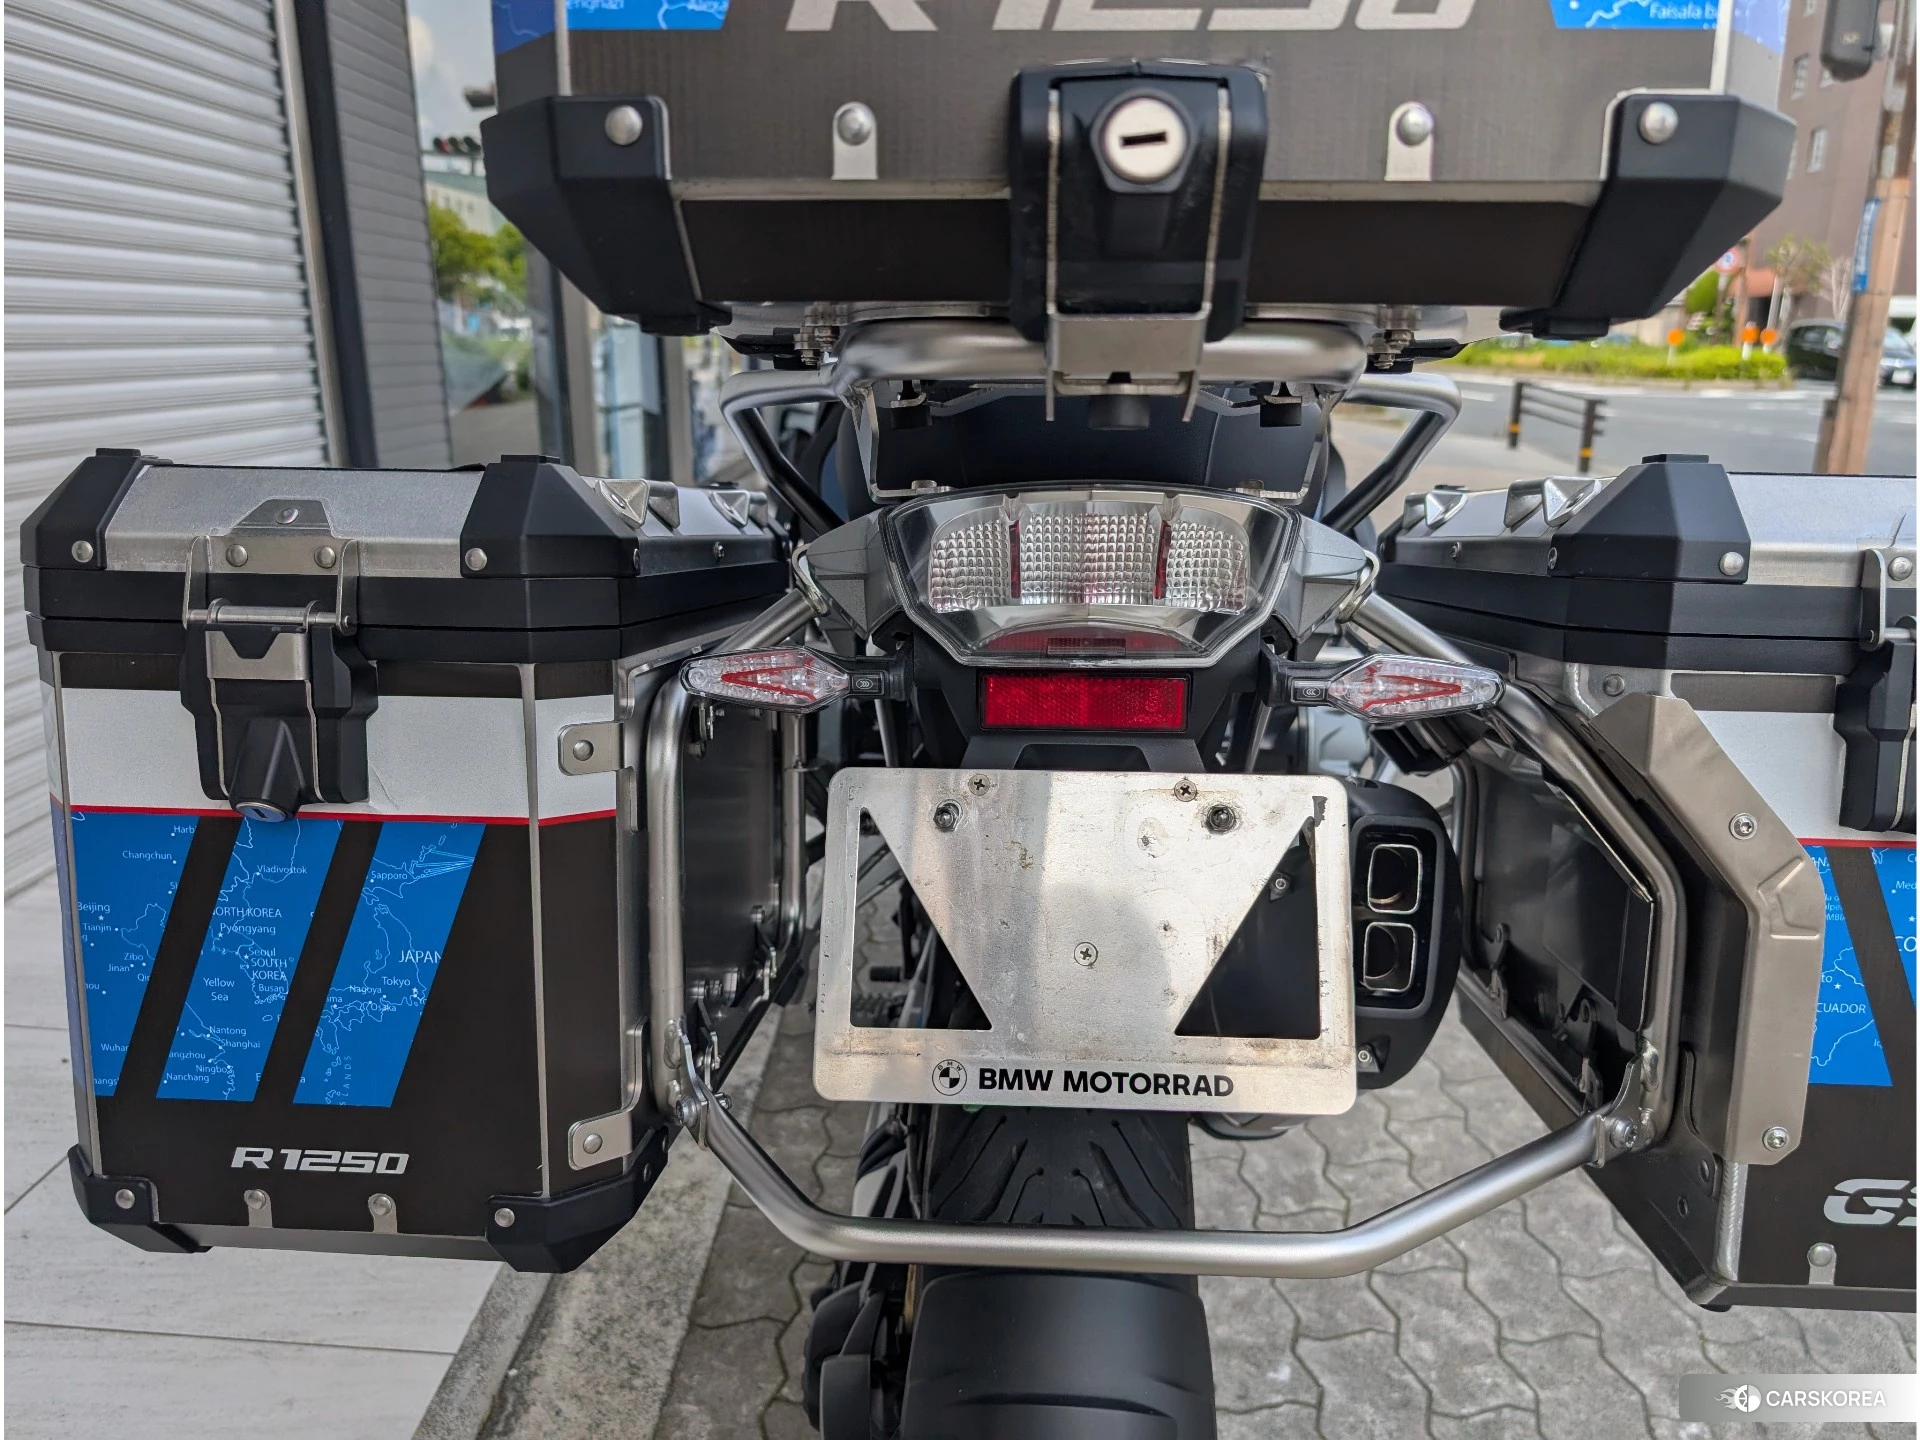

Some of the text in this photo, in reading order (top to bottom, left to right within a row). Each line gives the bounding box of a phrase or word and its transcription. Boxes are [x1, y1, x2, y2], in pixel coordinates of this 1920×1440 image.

[173, 825, 196, 833] Harb
[122, 850, 172, 861] Changchun
[257, 864, 307, 874] Vladivostok
[371, 870, 408, 881] Sapporo
[213, 906, 282, 918] ORTH KOREA
[82, 922, 112, 933] Tianjin
[220, 922, 276, 935] Pyongyang
[124, 952, 144, 961] Zibo
[249, 947, 276, 956] Seoul
[108, 964, 130, 972] Jinan
[250, 958, 288, 968] SOUTH
[252, 970, 287, 980] KOREA
[203, 977, 235, 988] Yellow
[382, 976, 411, 988] Tokyo
[258, 984, 285, 992] Busan
[350, 985, 382, 995] Nagoya
[211, 992, 229, 1001] Sea
[371, 1002, 397, 1012] Osaka
[209, 1026, 247, 1036] Nantong
[221, 1039, 261, 1049] Shanghai
[195, 1065, 228, 1074] Ningbo
[166, 1073, 209, 1083] Nanchang
[978, 1067, 1234, 1097] BMW MOTORRAD
[231, 1146, 409, 1175] R 1250
[1823, 1178, 1917, 1227] G
